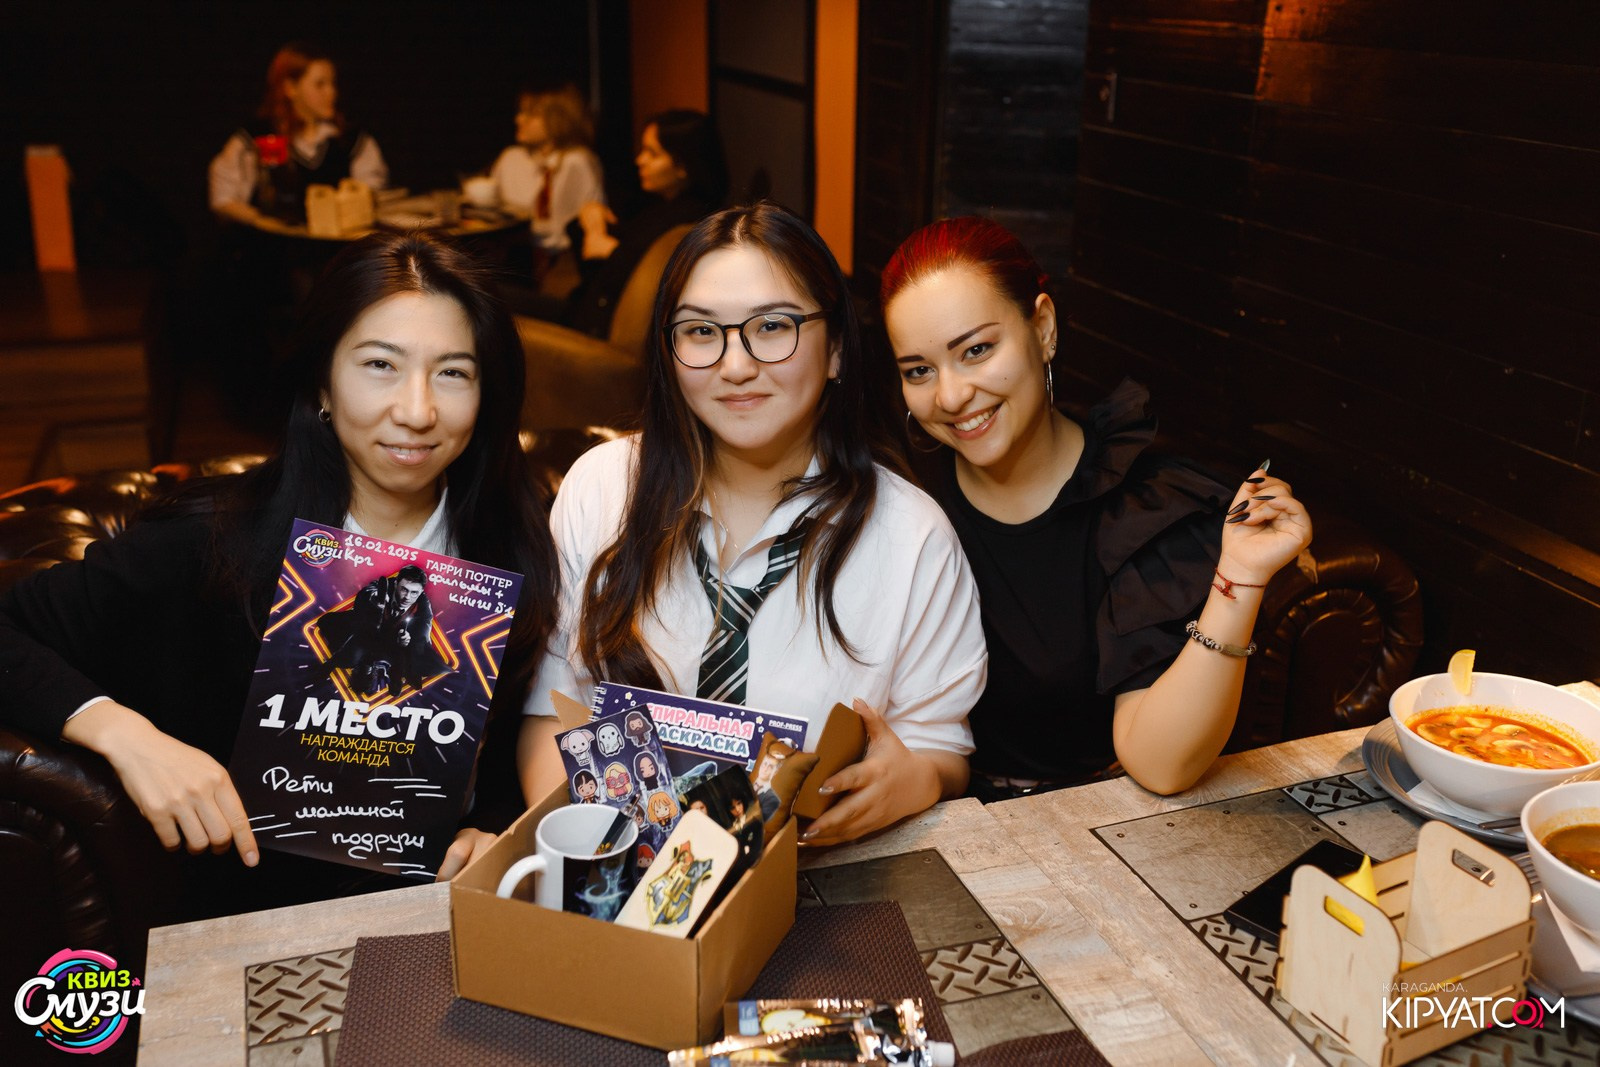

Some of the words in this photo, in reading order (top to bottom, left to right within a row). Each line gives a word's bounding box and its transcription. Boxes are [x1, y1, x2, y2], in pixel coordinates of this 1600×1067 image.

[293, 536, 343, 559] Смузи
[314, 537, 340, 549] КВИЗ
[344, 534, 419, 561] 16.02.2025
[426, 559, 463, 577] ГАРРИ
[465, 569, 513, 589] ПОТТЕР
[428, 573, 492, 596] фильмы
[259, 693, 286, 729] 1
[294, 696, 466, 745] МЕСТО
[768, 719, 803, 733] PROF-PRESS
[300, 733, 416, 755] НАГРАЖДАЕТСЯ
[657, 724, 748, 755] АСКРАСКА
[317, 749, 391, 767] КОМАНДА
[262, 766, 334, 795] Дети
[295, 800, 405, 819] маминой
[332, 832, 425, 860] подруги
